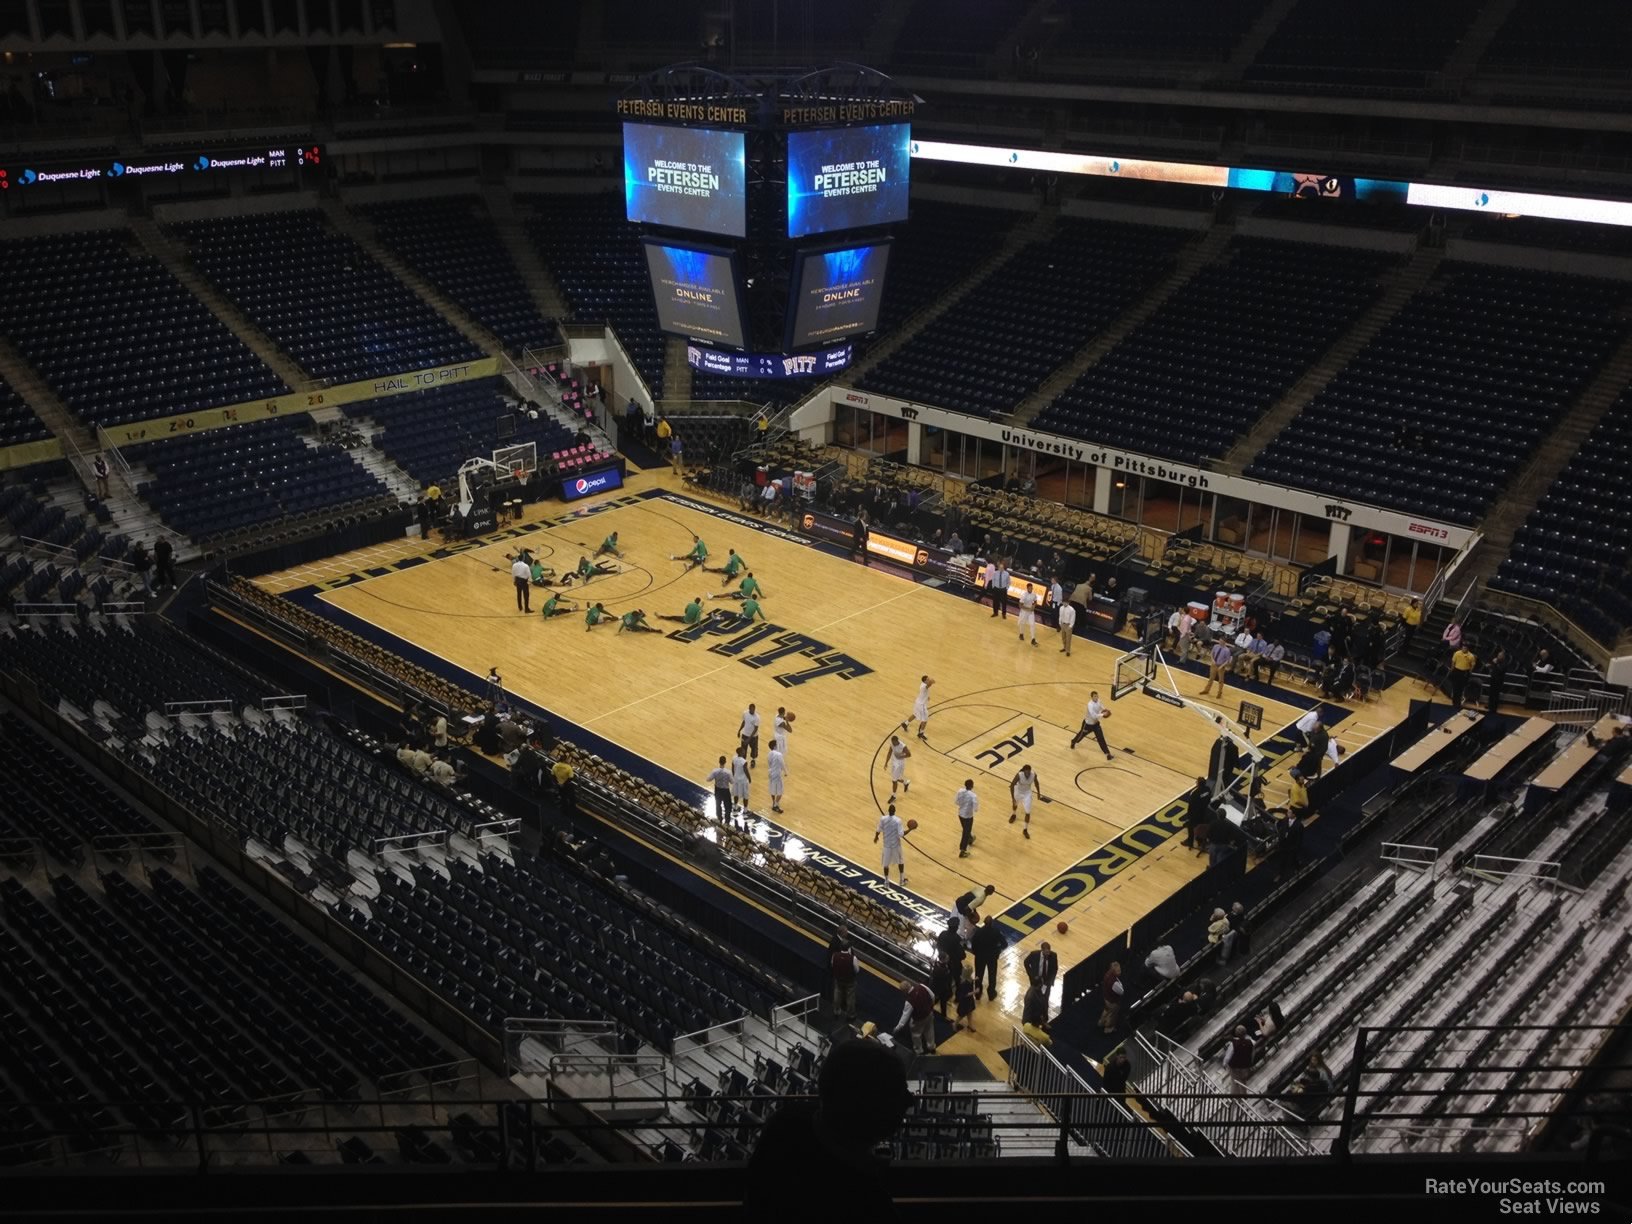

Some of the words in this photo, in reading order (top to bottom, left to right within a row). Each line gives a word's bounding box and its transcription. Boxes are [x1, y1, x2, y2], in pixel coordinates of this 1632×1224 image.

[617, 100, 664, 116] PETERSEN
[668, 104, 704, 120] EVENTS
[708, 106, 746, 123] CENTER
[784, 107, 836, 123] PETERSEN
[840, 104, 876, 119] EVENTS
[879, 100, 914, 118] CENTER
[126, 165, 163, 175] Duquesne
[164, 161, 184, 172] Light
[211, 159, 246, 169] Duquesne
[247, 156, 265, 166] Light
[270, 159, 286, 167] PITT
[654, 159, 686, 170] WELCOME
[687, 162, 697, 171] TO
[698, 164, 712, 173] THE
[822, 162, 854, 173] WELCOME
[856, 161, 865, 170] TO
[866, 160, 880, 169] THE
[38, 172, 79, 182] Duquesne
[80, 169, 101, 179] Light
[648, 167, 719, 190] PETERSEN
[814, 168, 886, 190] PETERSEN
[657, 184, 683, 195] EVENTS
[684, 187, 710, 198] CENTER
[823, 187, 850, 198] EVENTS
[851, 185, 877, 195] CENTER
[676, 288, 713, 303] ONLINE
[823, 288, 860, 303] ONLINE
[688, 347, 702, 367] ITT
[705, 353, 717, 362] Field
[717, 355, 730, 363] Goal
[704, 361, 732, 372] Percentage
[782, 355, 817, 376] PITT
[374, 379, 409, 393] HAIL
[414, 373, 434, 385] TO
[439, 365, 470, 380] PITT
[901, 407, 919, 420] PITT
[1001, 429, 1083, 460] University
[1091, 451, 1107, 465] of
[1113, 455, 1210, 489] Pittsburgh
[588, 476, 606, 489] pepsi
[1325, 505, 1352, 521] PITT
[664, 608, 875, 688] PITT
[975, 726, 1034, 769] ACC
